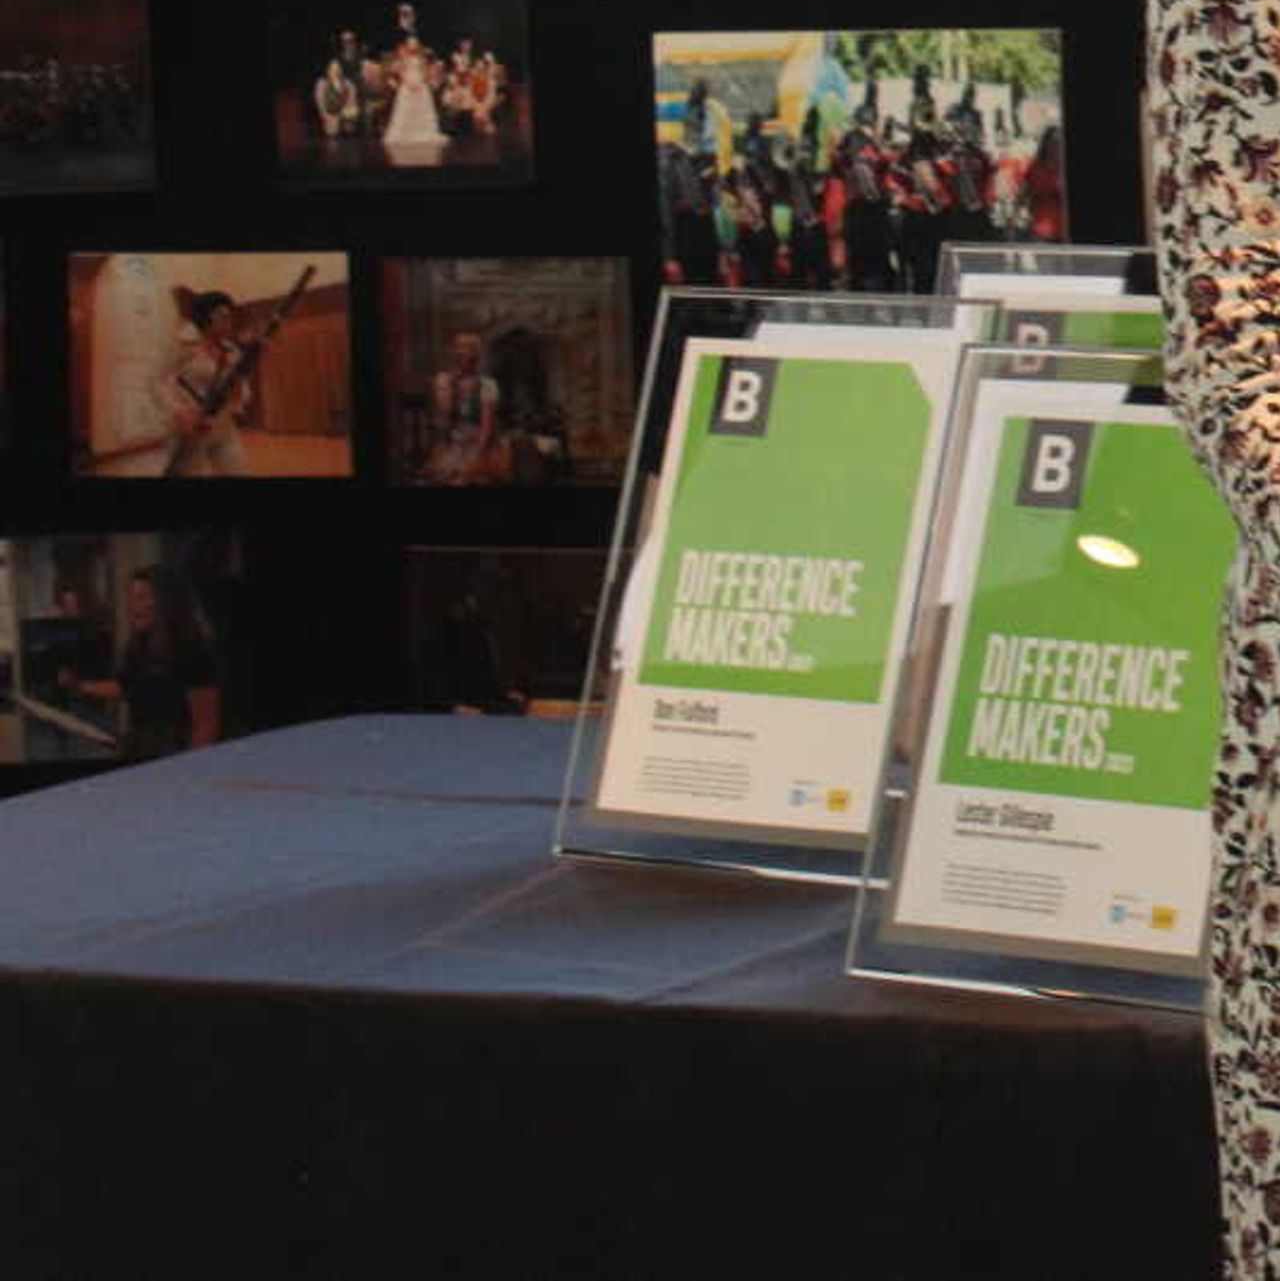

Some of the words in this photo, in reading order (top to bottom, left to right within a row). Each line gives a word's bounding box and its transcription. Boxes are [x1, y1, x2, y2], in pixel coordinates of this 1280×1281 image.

[721, 369, 764, 424] B
[1031, 433, 1077, 494] B
[674, 548, 866, 618] DIFFERENCE
[663, 606, 795, 670] MAKERS
[978, 631, 1194, 713] DIFFERENCE
[966, 696, 1112, 771] MAKERS
